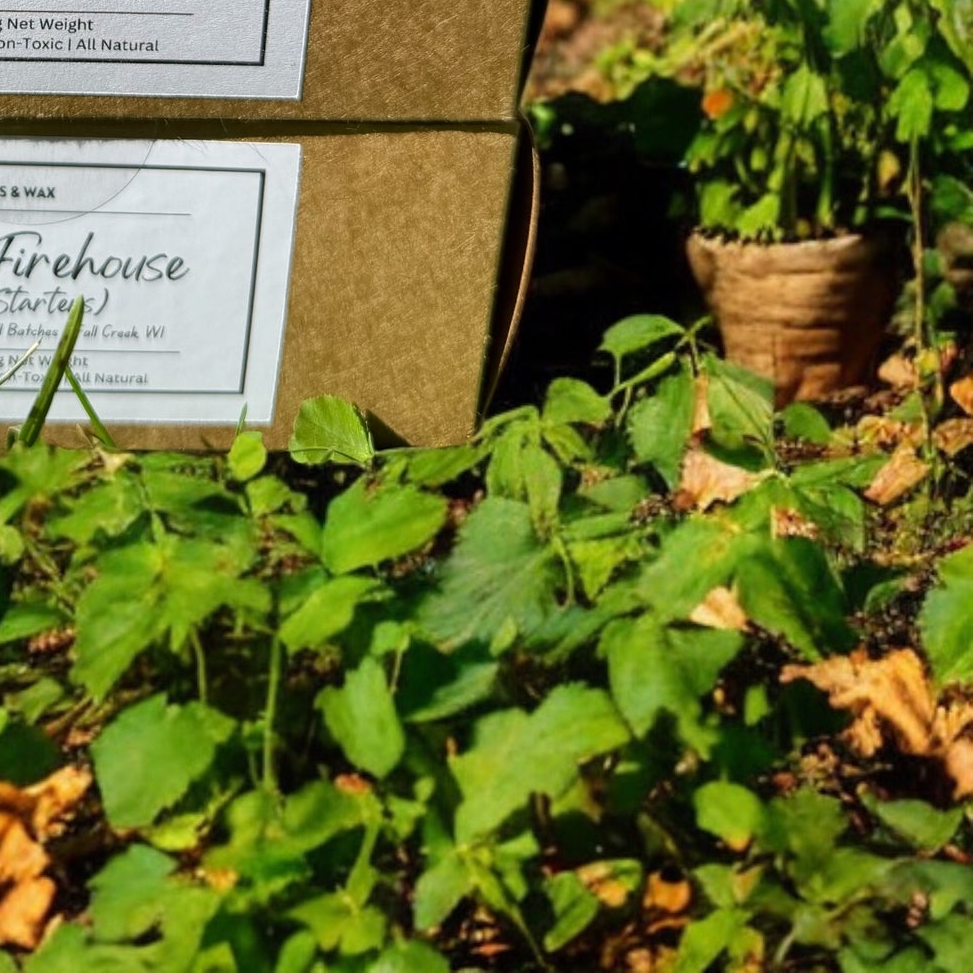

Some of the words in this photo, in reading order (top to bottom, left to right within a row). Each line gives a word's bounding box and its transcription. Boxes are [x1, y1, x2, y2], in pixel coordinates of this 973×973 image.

[7, 17, 35, 30] Net
[39, 17, 94, 33] Weight
[76, 38, 96, 51] All
[101, 39, 159, 52] Natural
[11, 185, 20, 198] &
[23, 186, 56, 199] WAX
[7, 322, 59, 337] Batches
[79, 324, 99, 337] all
[145, 324, 166, 339] WI
[95, 372, 148, 384] Natural
